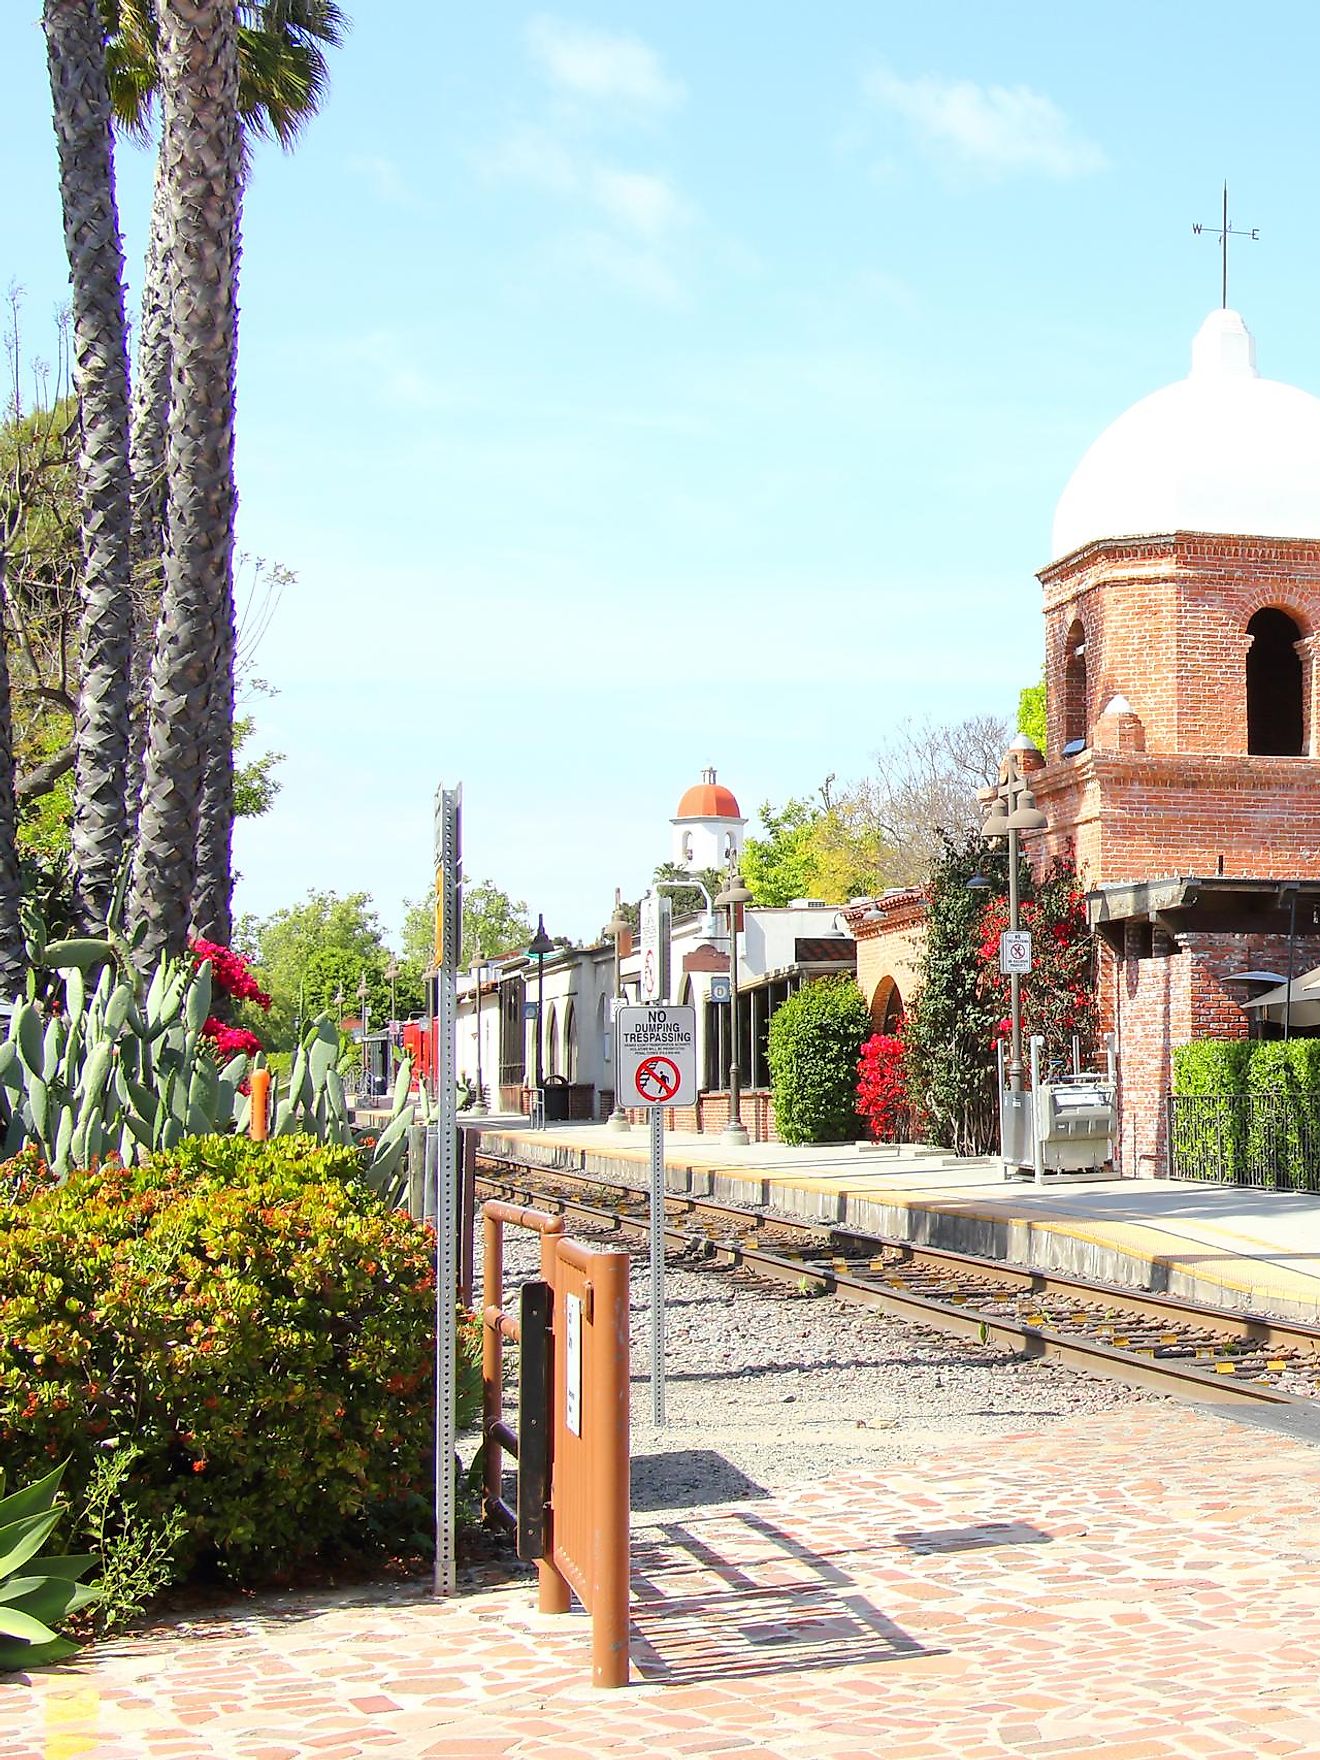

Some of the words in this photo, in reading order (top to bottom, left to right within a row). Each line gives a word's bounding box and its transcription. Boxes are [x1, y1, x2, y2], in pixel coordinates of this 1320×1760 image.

[1192, 223, 1202, 234] W
[1252, 229, 1260, 240] E
[648, 1010, 667, 1023] NO
[635, 1023, 680, 1032] DUMPING
[624, 1032, 691, 1042] TRESPASSING
